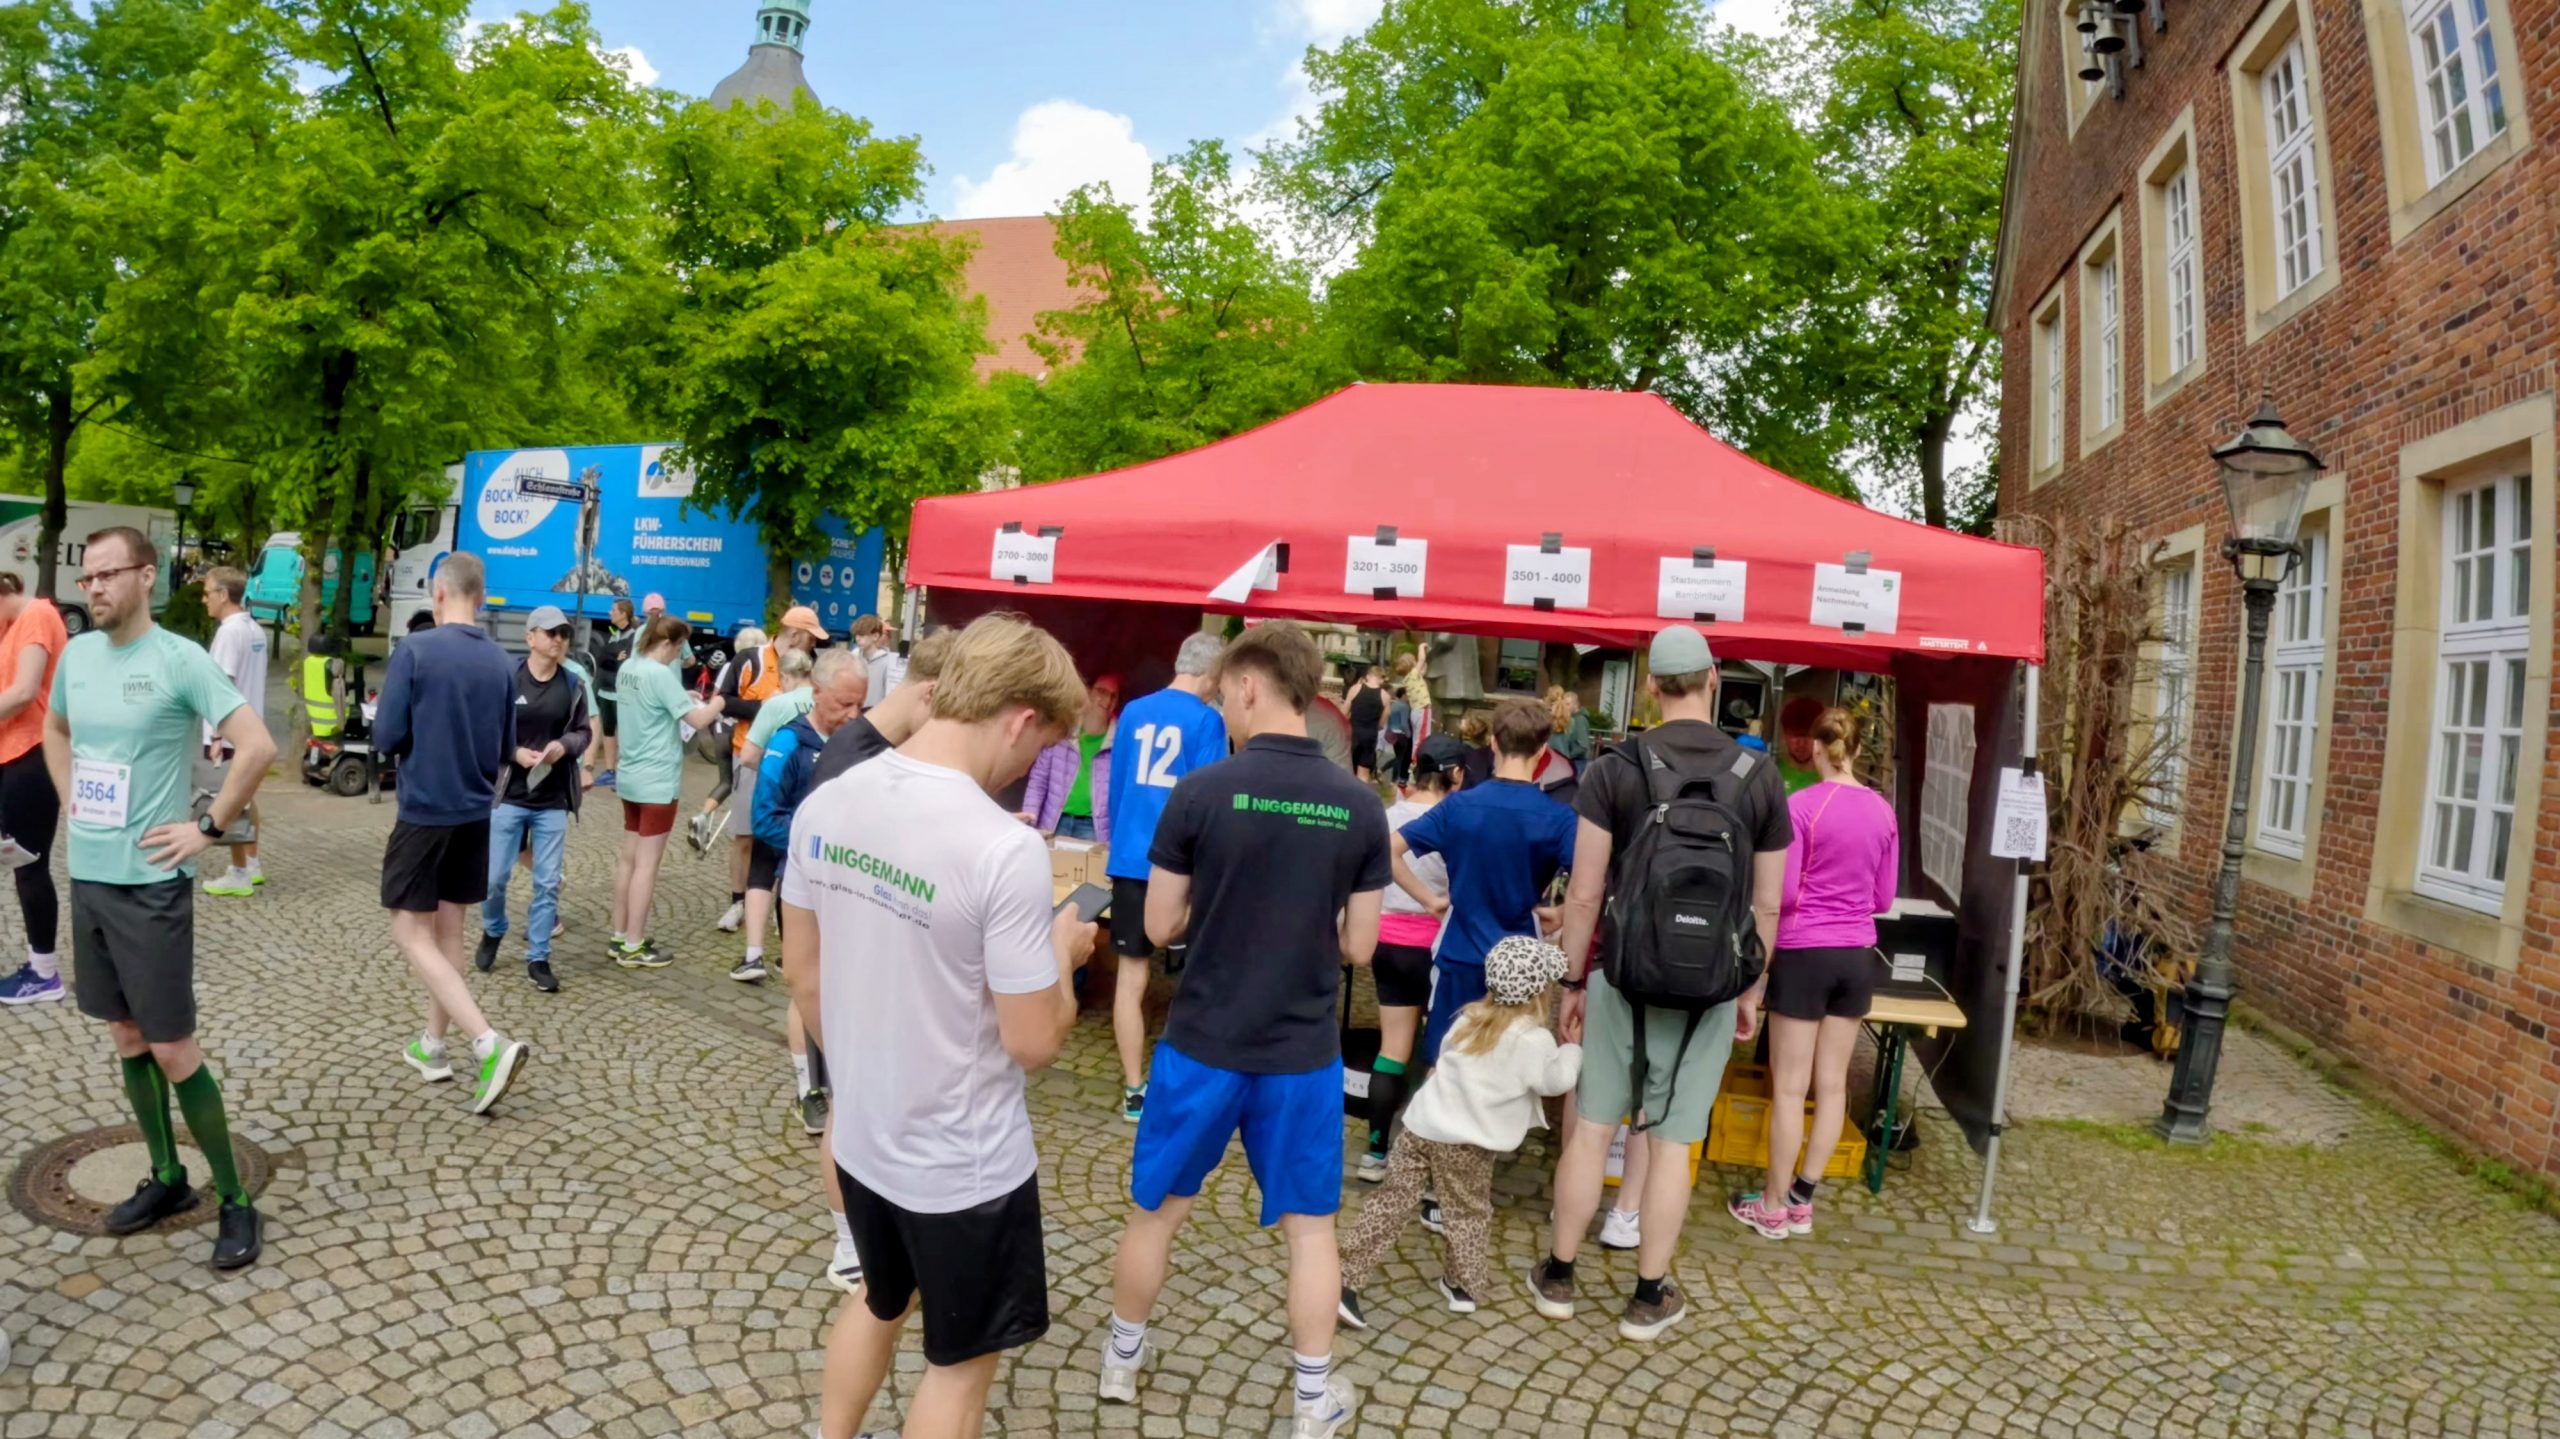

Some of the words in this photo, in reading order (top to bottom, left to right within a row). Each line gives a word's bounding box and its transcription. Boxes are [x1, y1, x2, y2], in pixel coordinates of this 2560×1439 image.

[485, 488, 512, 503] BOCK
[494, 509, 530, 524] BOCK?
[634, 517, 663, 531] LKW-
[632, 532, 723, 552] FÜHRERSCHEIN
[997, 550, 1020, 560] 2700
[1026, 551, 1049, 562] 3000
[1352, 560, 1380, 572] 3201
[1389, 562, 1419, 575] 3500
[1512, 570, 1541, 582] 3501
[1551, 572, 1582, 584] 4000
[1670, 575, 1732, 587] Startnummern
[1134, 723, 1181, 788] 12
[77, 779, 116, 803] 3564
[1252, 798, 1350, 821] NIGGEMANN
[824, 843, 936, 904] NIGGEMANN
[873, 884, 893, 902] Glas
[1675, 913, 1710, 926] Deloitte.
